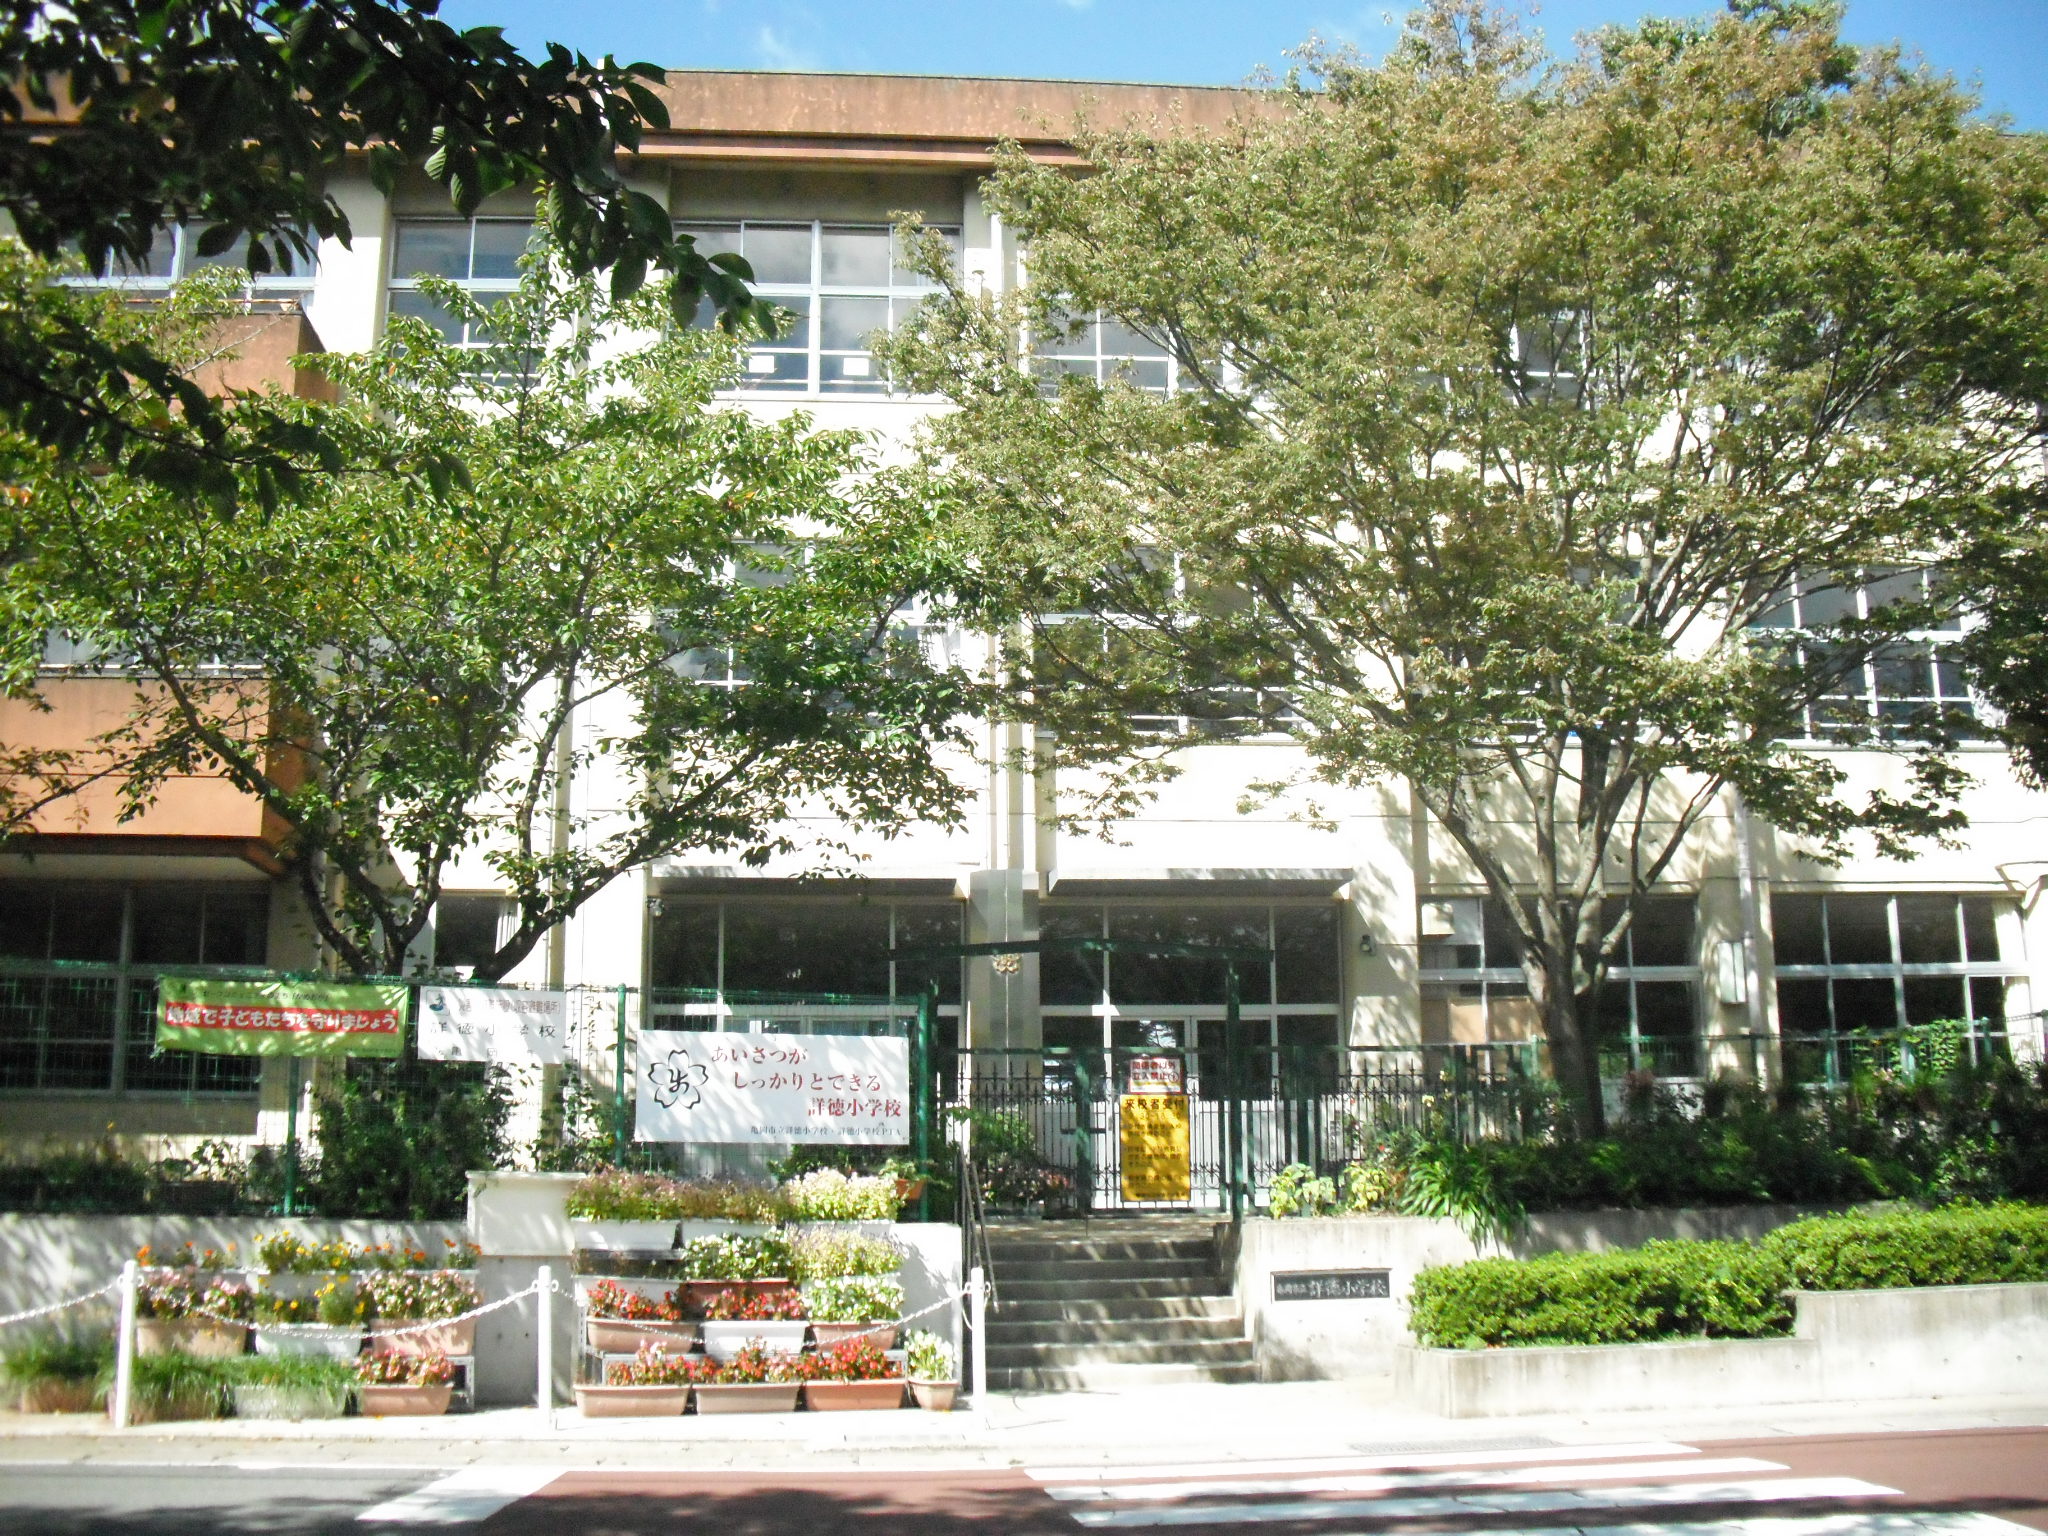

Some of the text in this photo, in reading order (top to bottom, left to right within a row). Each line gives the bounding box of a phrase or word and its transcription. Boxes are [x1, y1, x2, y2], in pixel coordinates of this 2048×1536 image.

[167, 1006, 397, 1030] 地域で子どもたちを守りましょう
[711, 1048, 806, 1065] あいさつが
[734, 1072, 881, 1092] しっかりとできる
[808, 1098, 902, 1118] 詳徳小学校
